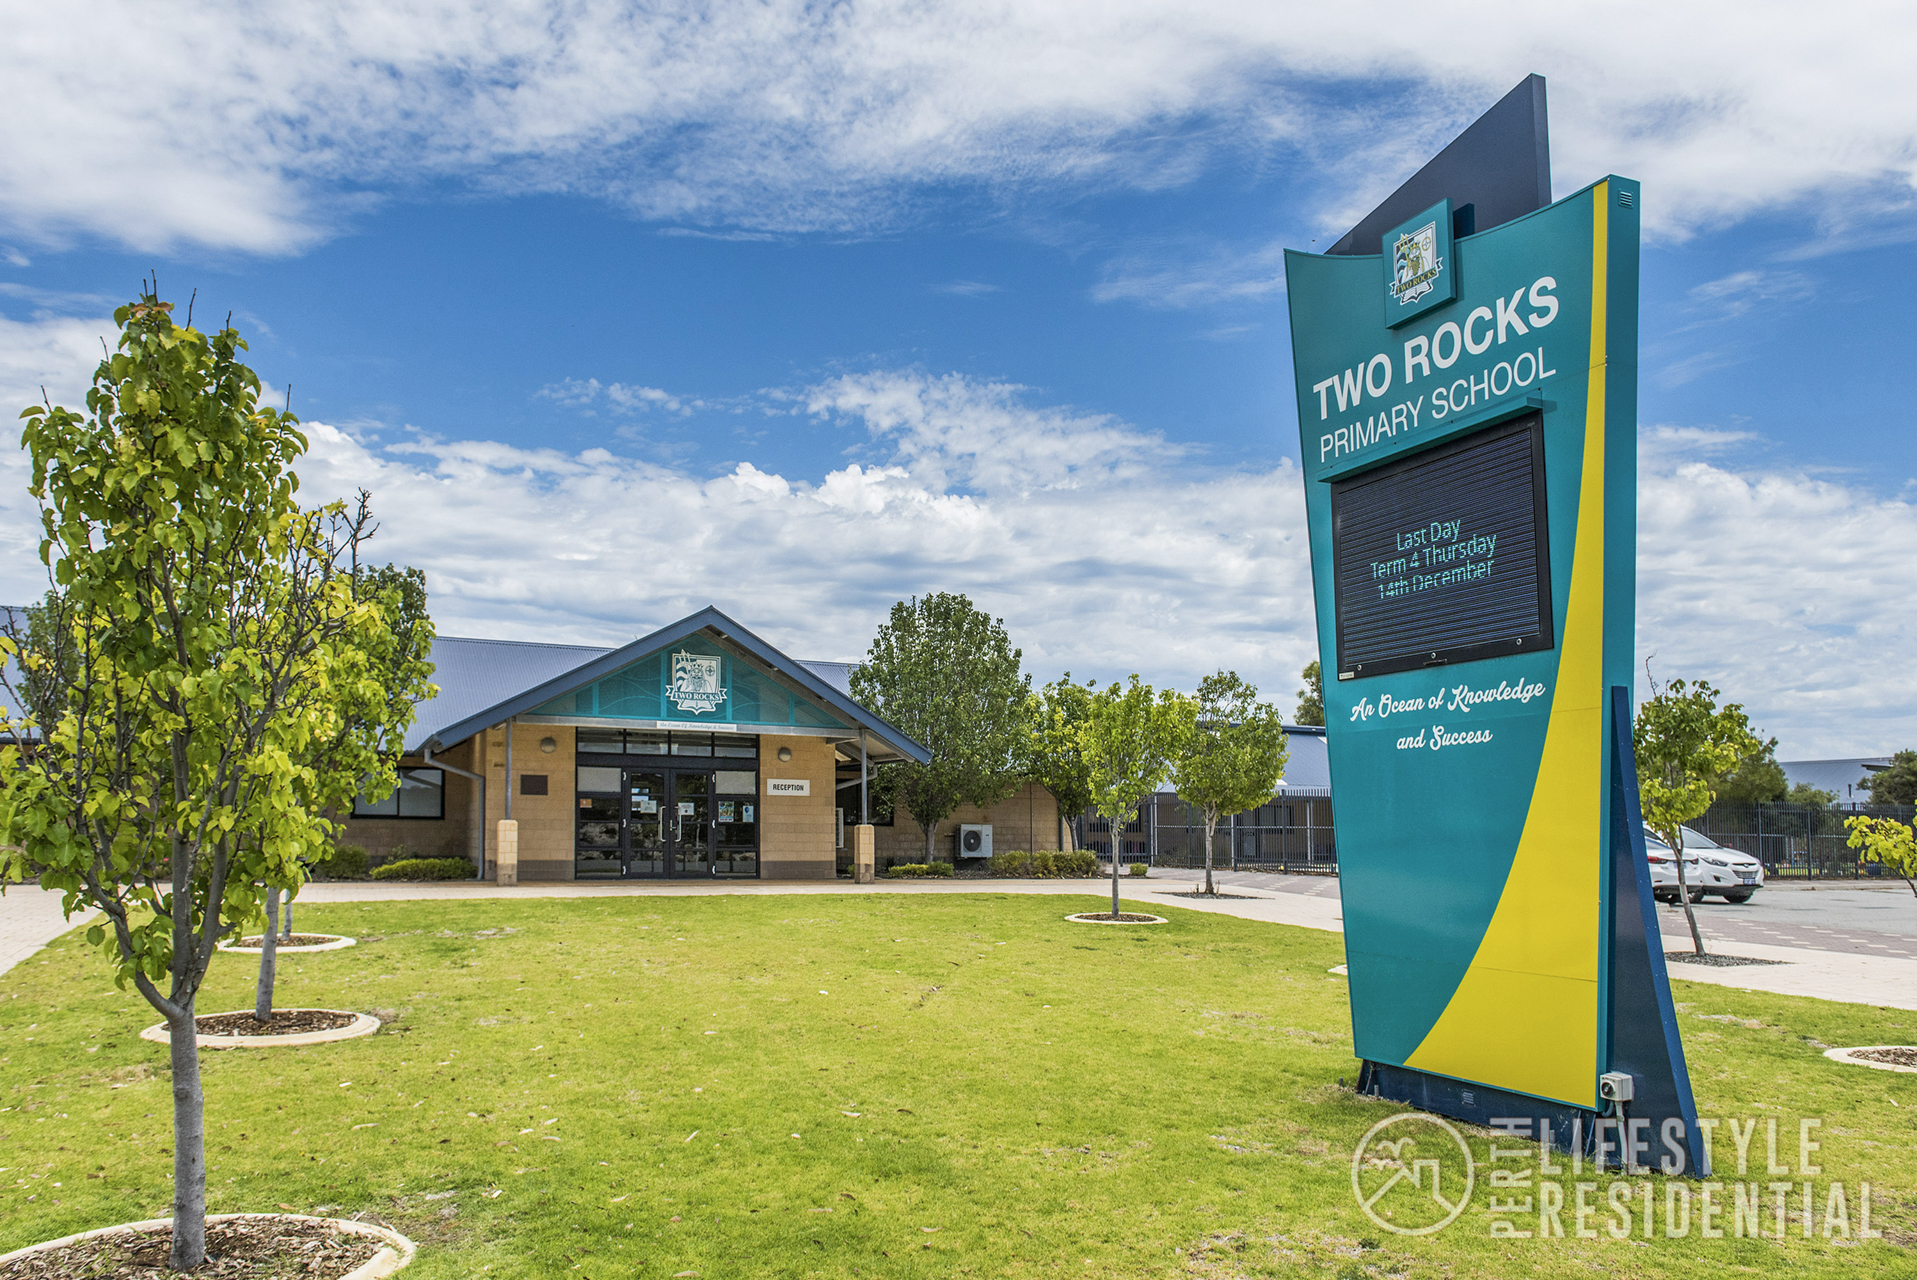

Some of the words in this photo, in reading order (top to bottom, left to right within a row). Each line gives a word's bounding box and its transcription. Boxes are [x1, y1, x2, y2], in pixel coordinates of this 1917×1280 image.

[1396, 281, 1412, 294] TWO
[1412, 268, 1437, 287] ROCKS
[1313, 353, 1392, 420] TWO
[1404, 276, 1559, 384] ROCKS
[1320, 395, 1424, 463] PRIMARY
[1432, 347, 1556, 419] SCHOOL
[1396, 527, 1427, 551] Last
[1430, 519, 1461, 542] Day
[1370, 558, 1406, 580] Term
[1409, 551, 1421, 568] 4
[1424, 534, 1497, 567] Thursday
[1378, 576, 1410, 599] 14th
[1412, 559, 1495, 592] December
[1350, 697, 1375, 722] An
[1378, 693, 1425, 718] Ocean
[1428, 687, 1445, 709] of
[1447, 677, 1546, 713] Knowledge
[1396, 728, 1427, 750] and
[1429, 725, 1493, 751] Success
[772, 783, 805, 791] RECEPTION
